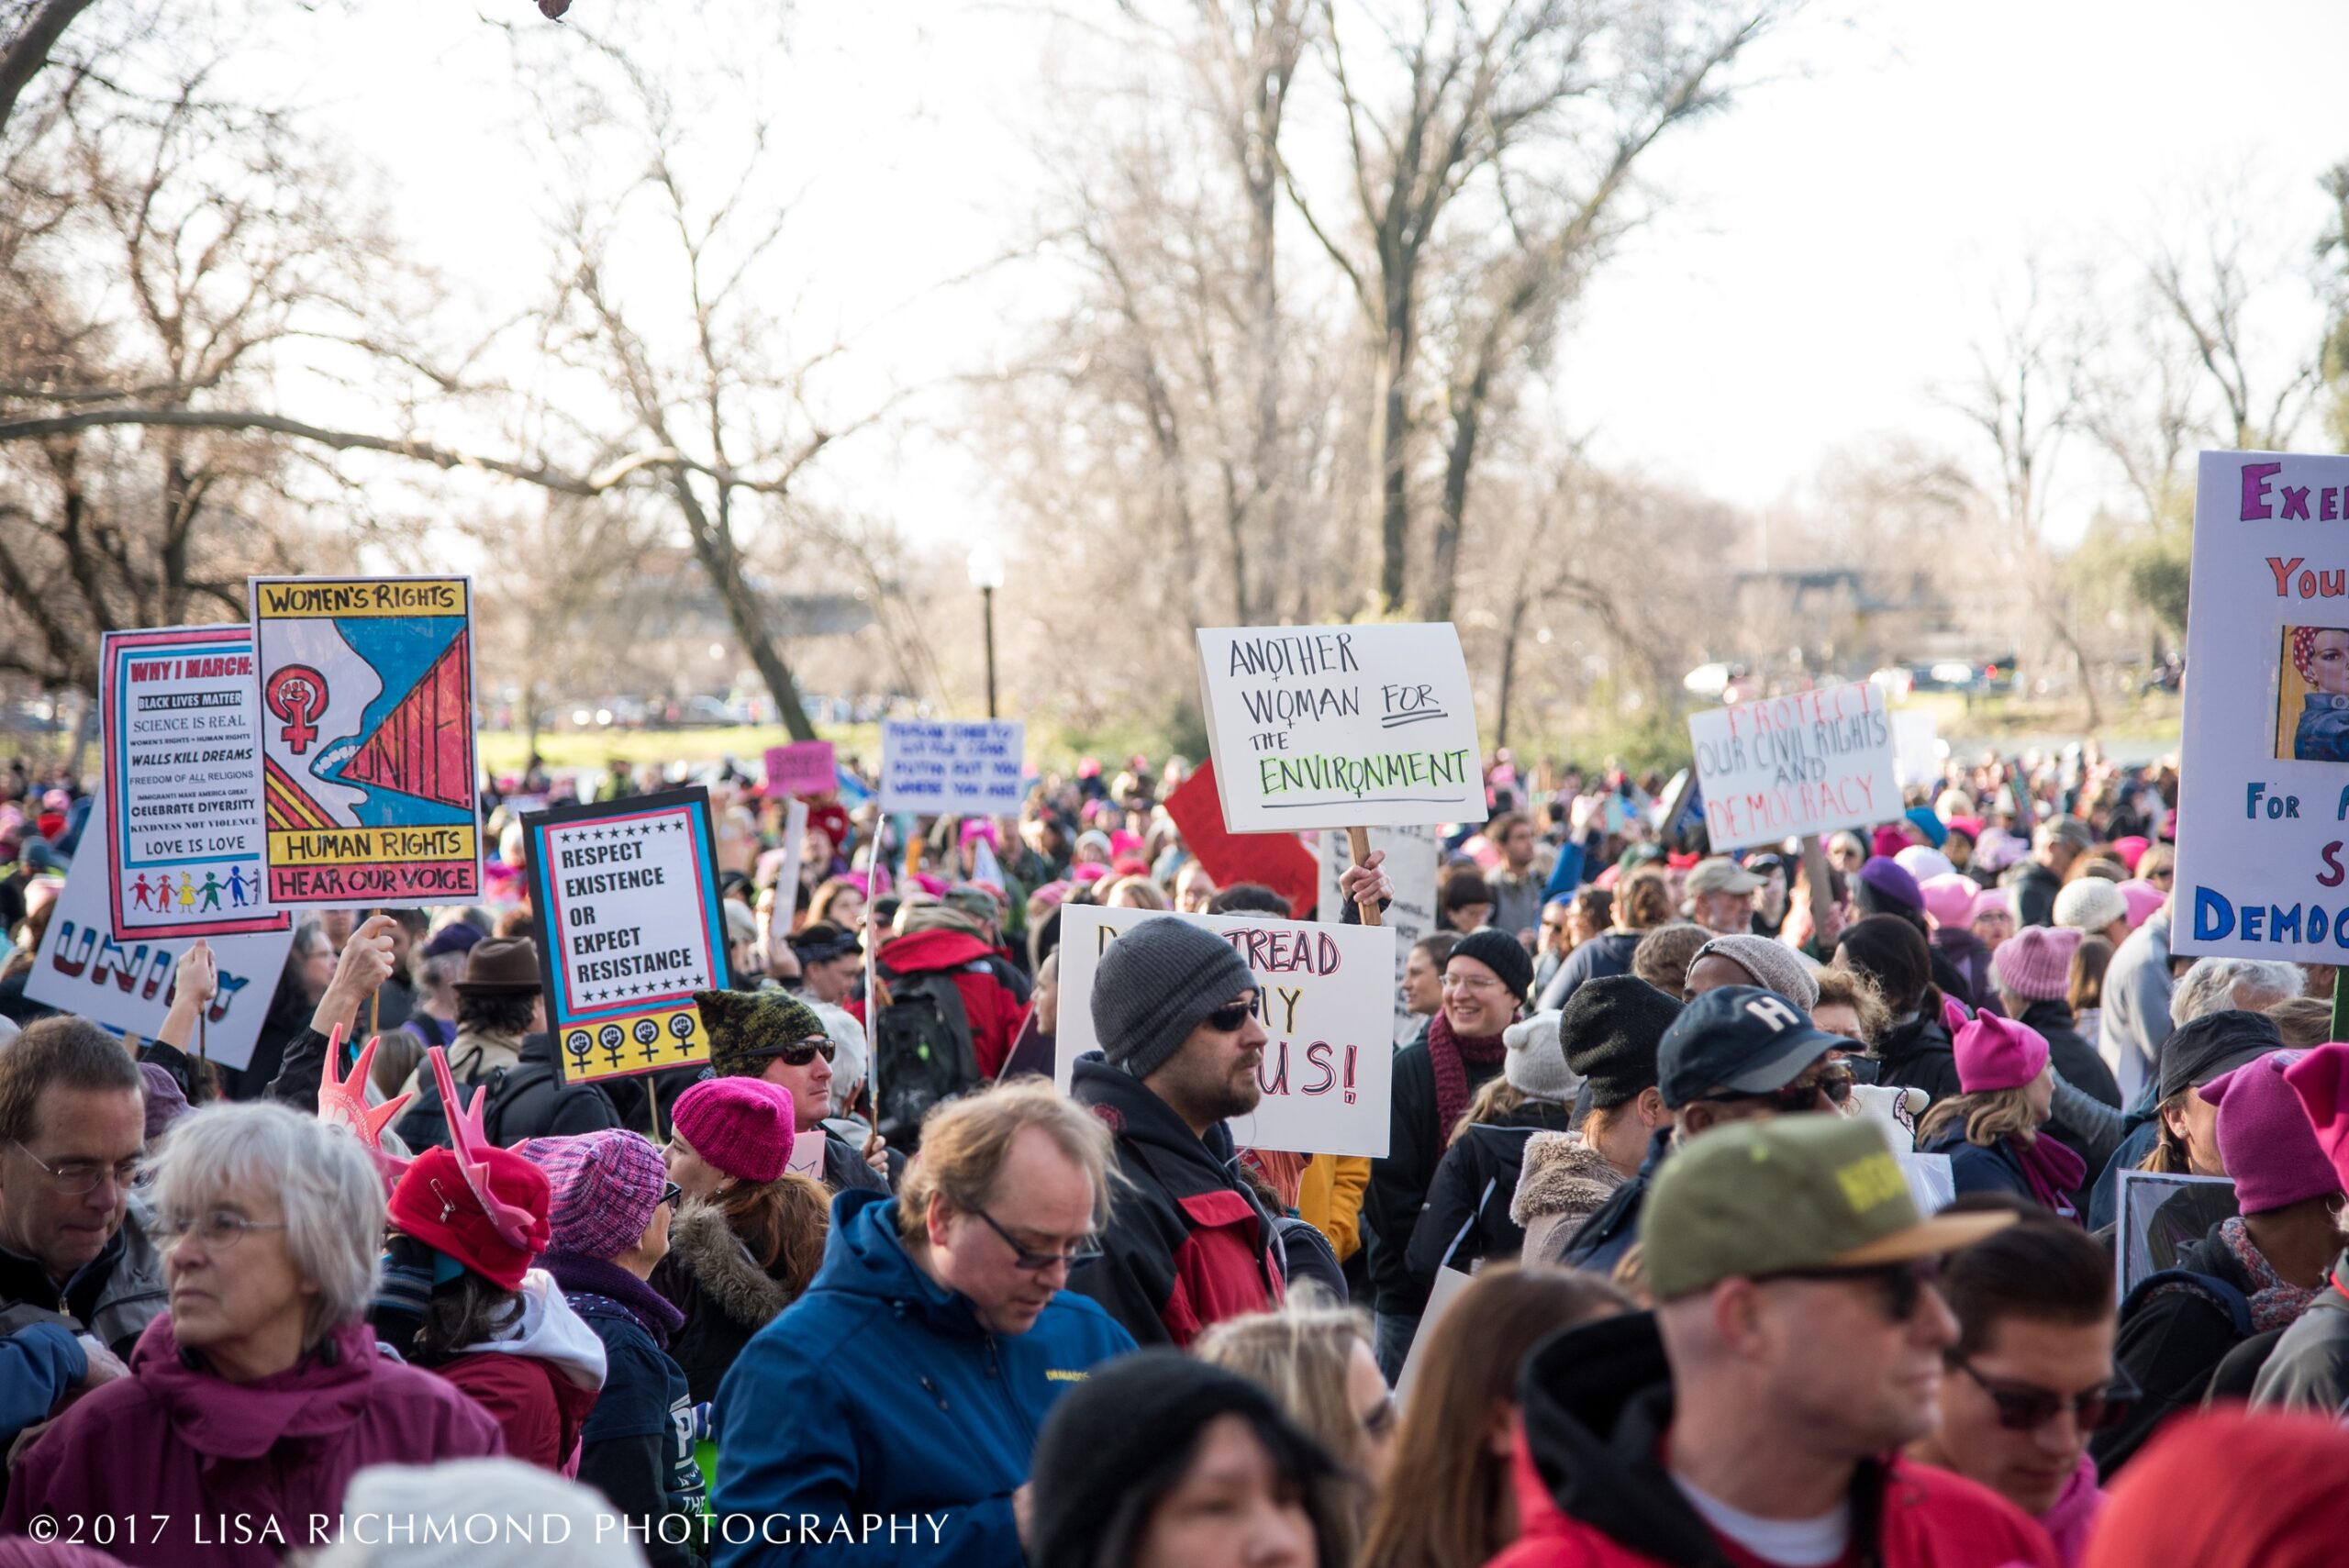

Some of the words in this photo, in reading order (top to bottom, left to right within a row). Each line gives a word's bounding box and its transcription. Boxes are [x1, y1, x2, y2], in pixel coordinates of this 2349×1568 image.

[266, 585, 369, 613] WOMEN'S
[372, 584, 456, 609] RIGHTS
[130, 661, 173, 683] WHY
[174, 661, 182, 680] I
[185, 656, 252, 679] MARCH:
[1230, 632, 1360, 682] ANOTHER
[139, 697, 169, 710] BLACK
[172, 695, 199, 708] LIVES
[201, 693, 241, 706] MATTER
[1241, 686, 1360, 728] WOMAN
[1381, 684, 1441, 716] FOR
[1727, 683, 1871, 737] PROTECT
[133, 717, 188, 733] SCIENCE
[193, 717, 205, 729] IS
[209, 715, 246, 728] REAL
[130, 738, 163, 747] WOMEN'S
[165, 737, 190, 745] RIGHTS
[196, 735, 224, 743] HUMAN
[225, 733, 250, 741] RIGHTS
[1249, 731, 1289, 751] THE
[1698, 736, 1746, 778] OUR
[1754, 727, 1807, 769] CIVIL
[1813, 709, 1887, 757] RIGHTS
[132, 753, 171, 767] WALLS
[173, 751, 199, 764] KILL
[202, 748, 253, 762] DREAMS
[129, 775, 173, 785] FREEDOM
[174, 774, 186, 783] OF
[189, 773, 206, 783] ALL
[207, 770, 253, 781] RELIGIONS
[1260, 749, 1469, 798] ENVIRONMENT
[1775, 757, 1827, 787] AND
[131, 803, 195, 817] CELEBRATE
[198, 798, 255, 813] DIVERSITY
[1709, 773, 1875, 840] DEMOCRACY
[2247, 783, 2299, 819] FOR
[130, 824, 182, 833] KINDNESS
[184, 821, 206, 830] NOT
[208, 817, 259, 828] VIOLENCE
[146, 840, 183, 855] LOVE
[189, 839, 203, 852] IS
[208, 836, 245, 851] LOVE
[287, 832, 372, 861] HUMAN
[380, 830, 462, 856] RIGHTS
[562, 841, 643, 869] RESPECT
[278, 868, 346, 895] HEAR
[349, 870, 396, 892] OUR
[400, 867, 472, 890] VOICE
[565, 867, 664, 897] EXISTENCE
[570, 906, 596, 927] OR
[573, 927, 640, 955] EXPECT
[52, 920, 250, 1023] UNIY
[577, 949, 692, 984] RESISTANCE
[1745, 995, 1800, 1032] H
